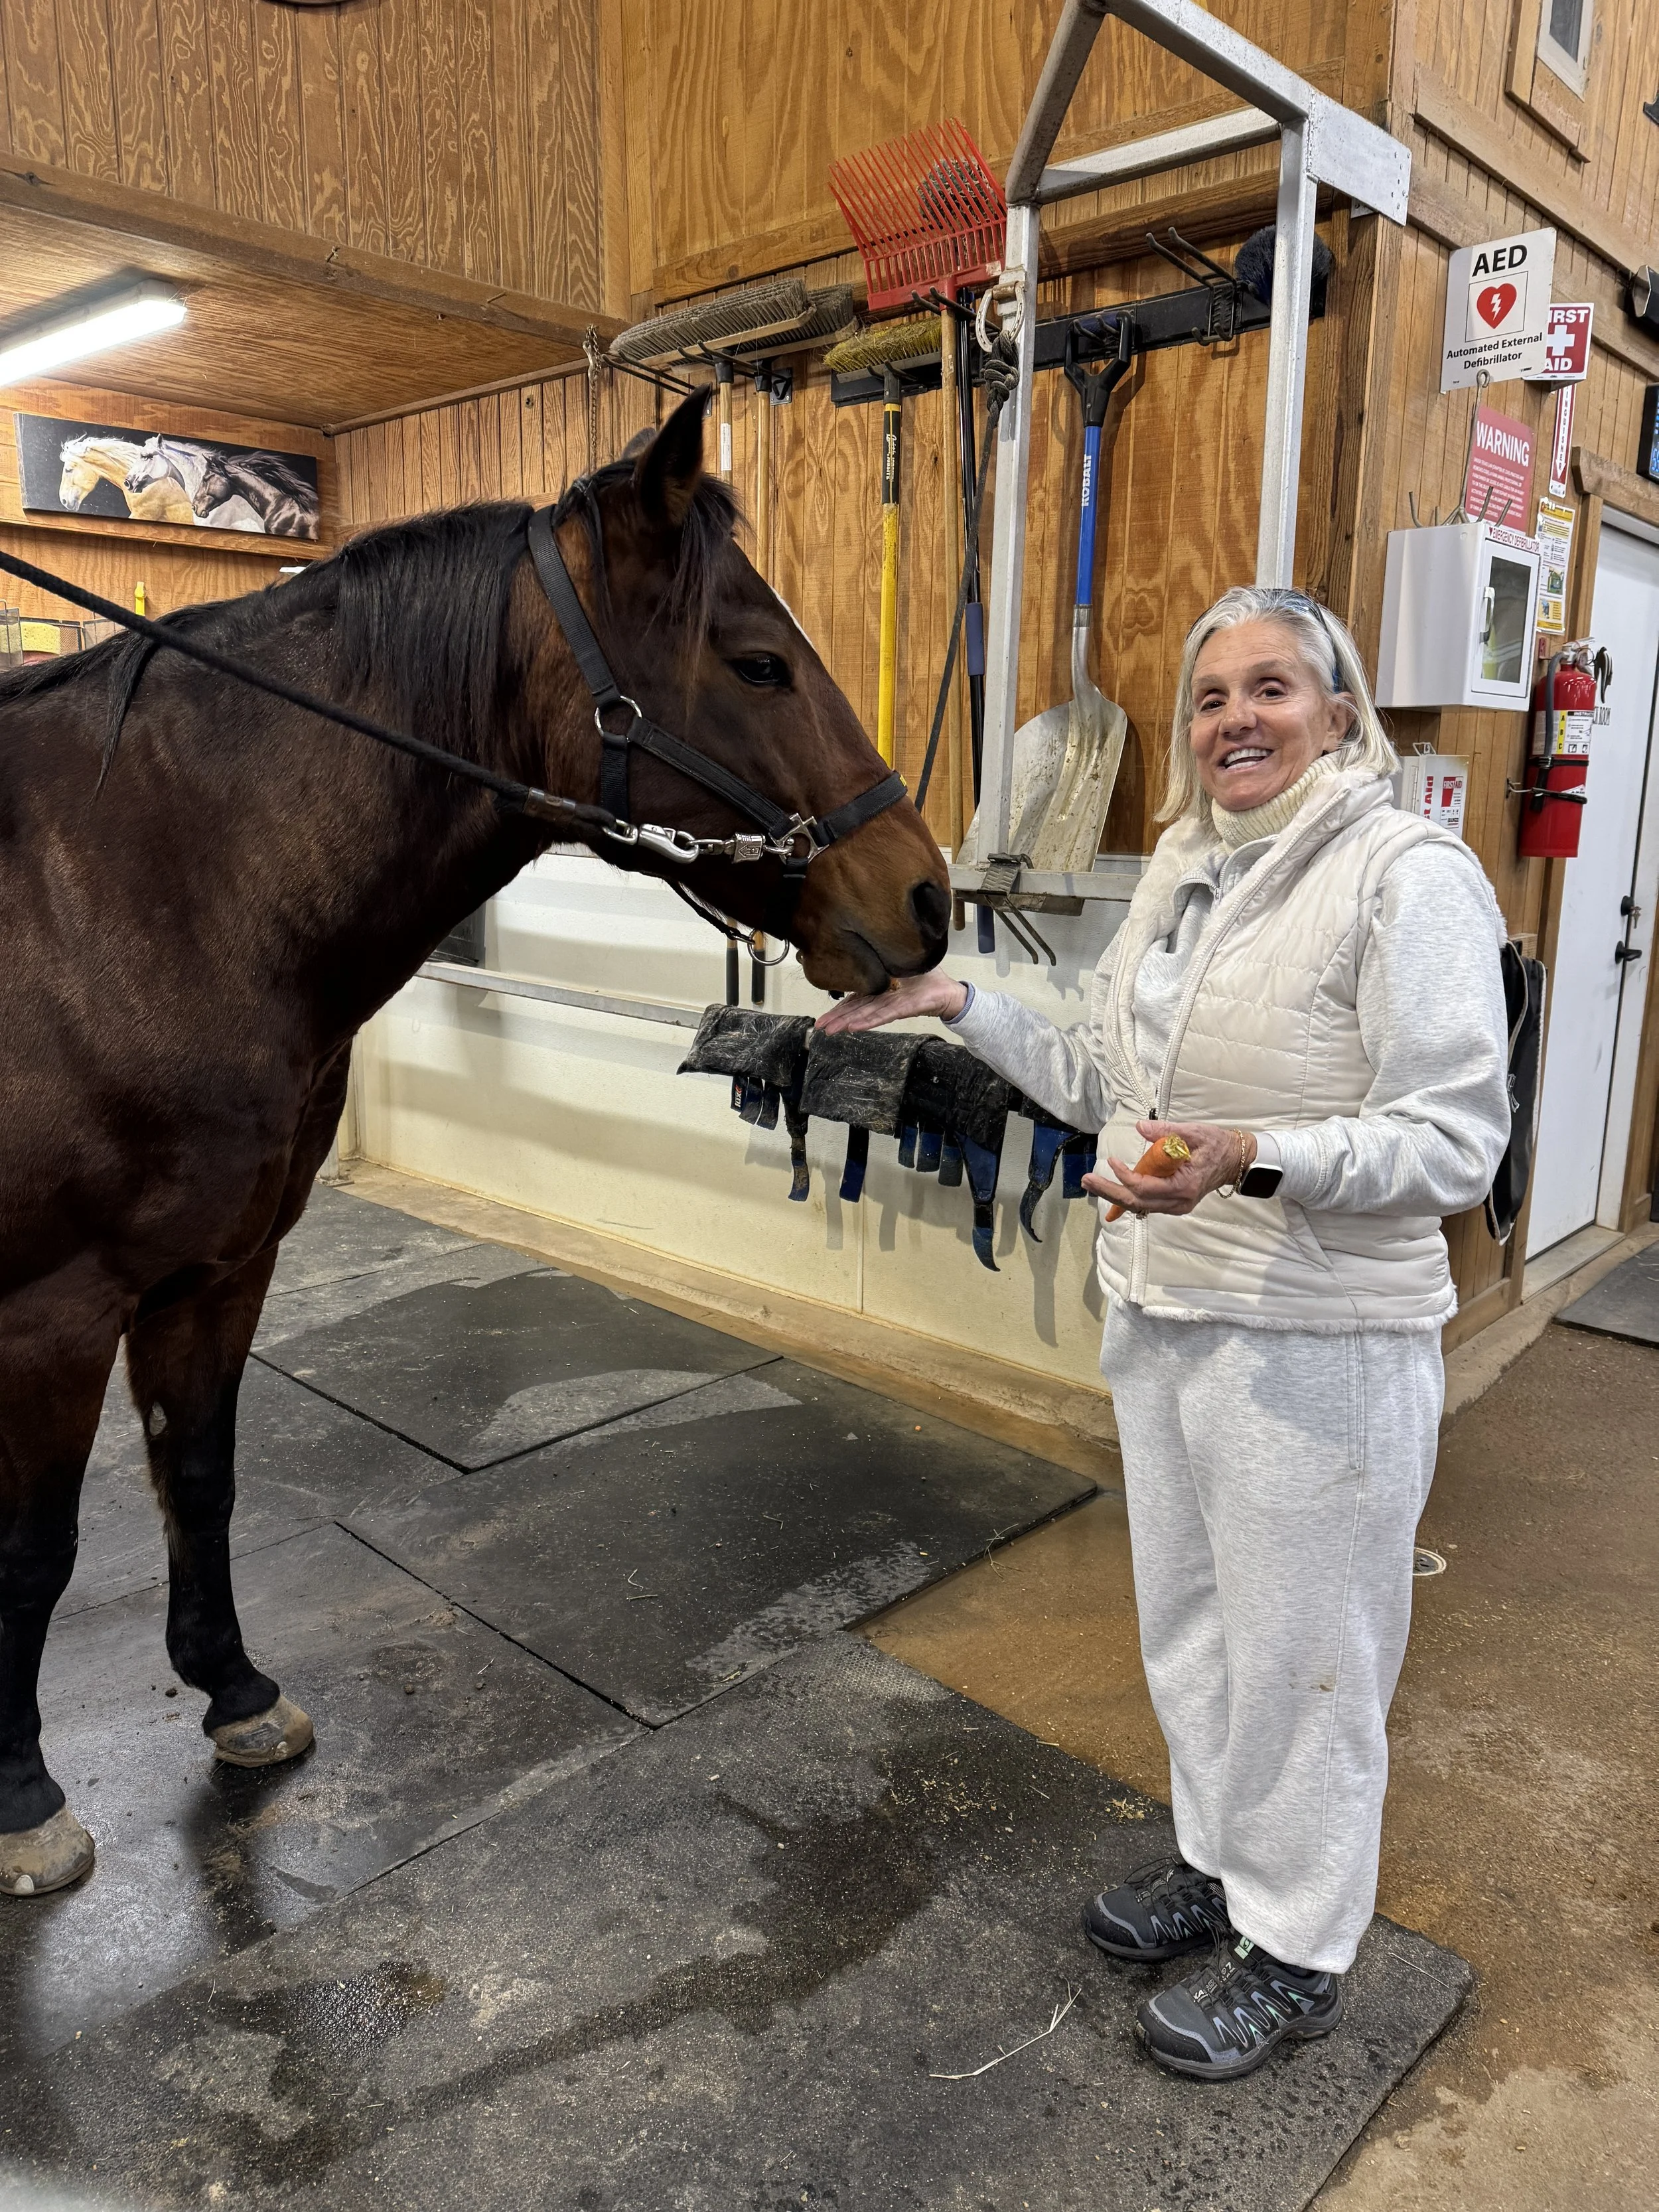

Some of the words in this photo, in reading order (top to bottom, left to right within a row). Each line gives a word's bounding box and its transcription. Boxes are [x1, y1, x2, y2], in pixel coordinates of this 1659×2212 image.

[1472, 244, 1528, 277] AED
[1548, 309, 1589, 324] IRST
[1446, 340, 1500, 360] Automated
[1501, 332, 1543, 349] External
[1463, 352, 1523, 370] Defibrillator
[1544, 357, 1573, 372] AID
[1477, 420, 1530, 467] WARNING
[1081, 453, 1092, 507] KOBALT
